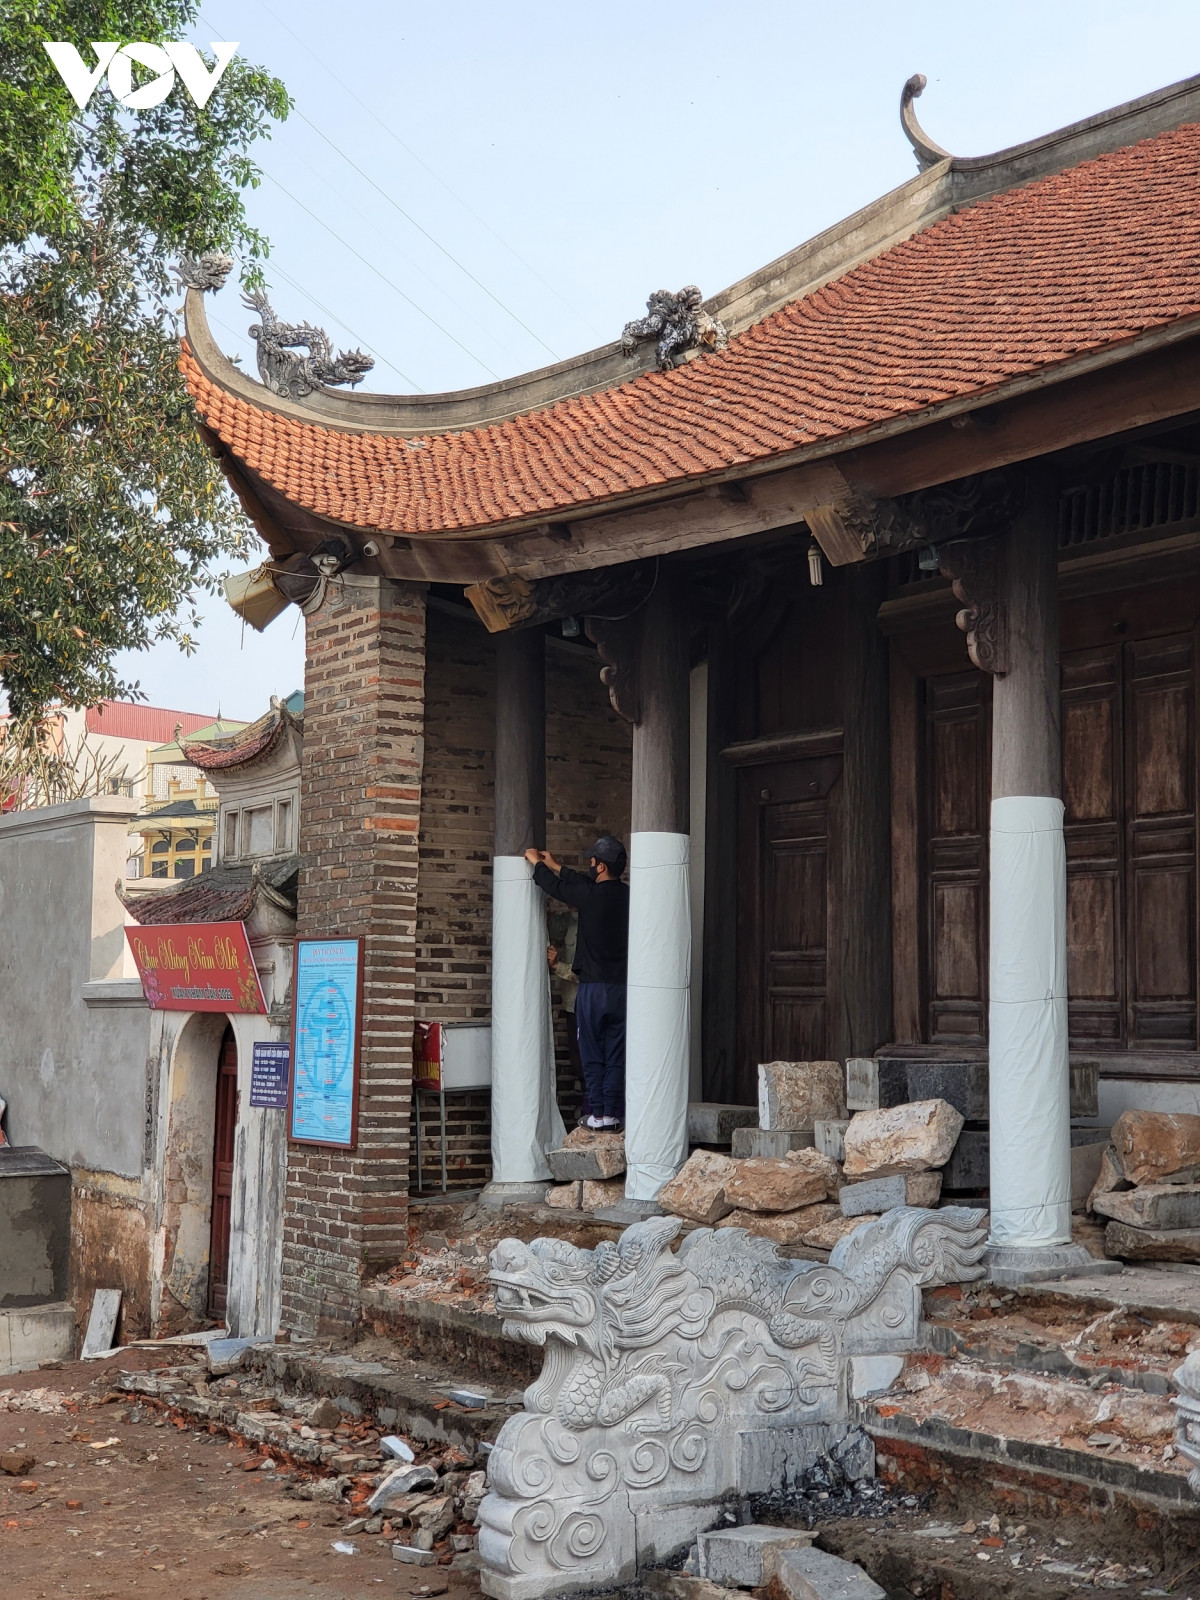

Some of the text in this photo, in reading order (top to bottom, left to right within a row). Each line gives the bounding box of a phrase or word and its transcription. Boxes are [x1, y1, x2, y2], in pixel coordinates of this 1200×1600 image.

[134, 937, 159, 969] Chúc
[188, 936, 216, 970] Năm
[213, 935, 240, 970] Mới
[218, 988, 234, 1001] 2022
